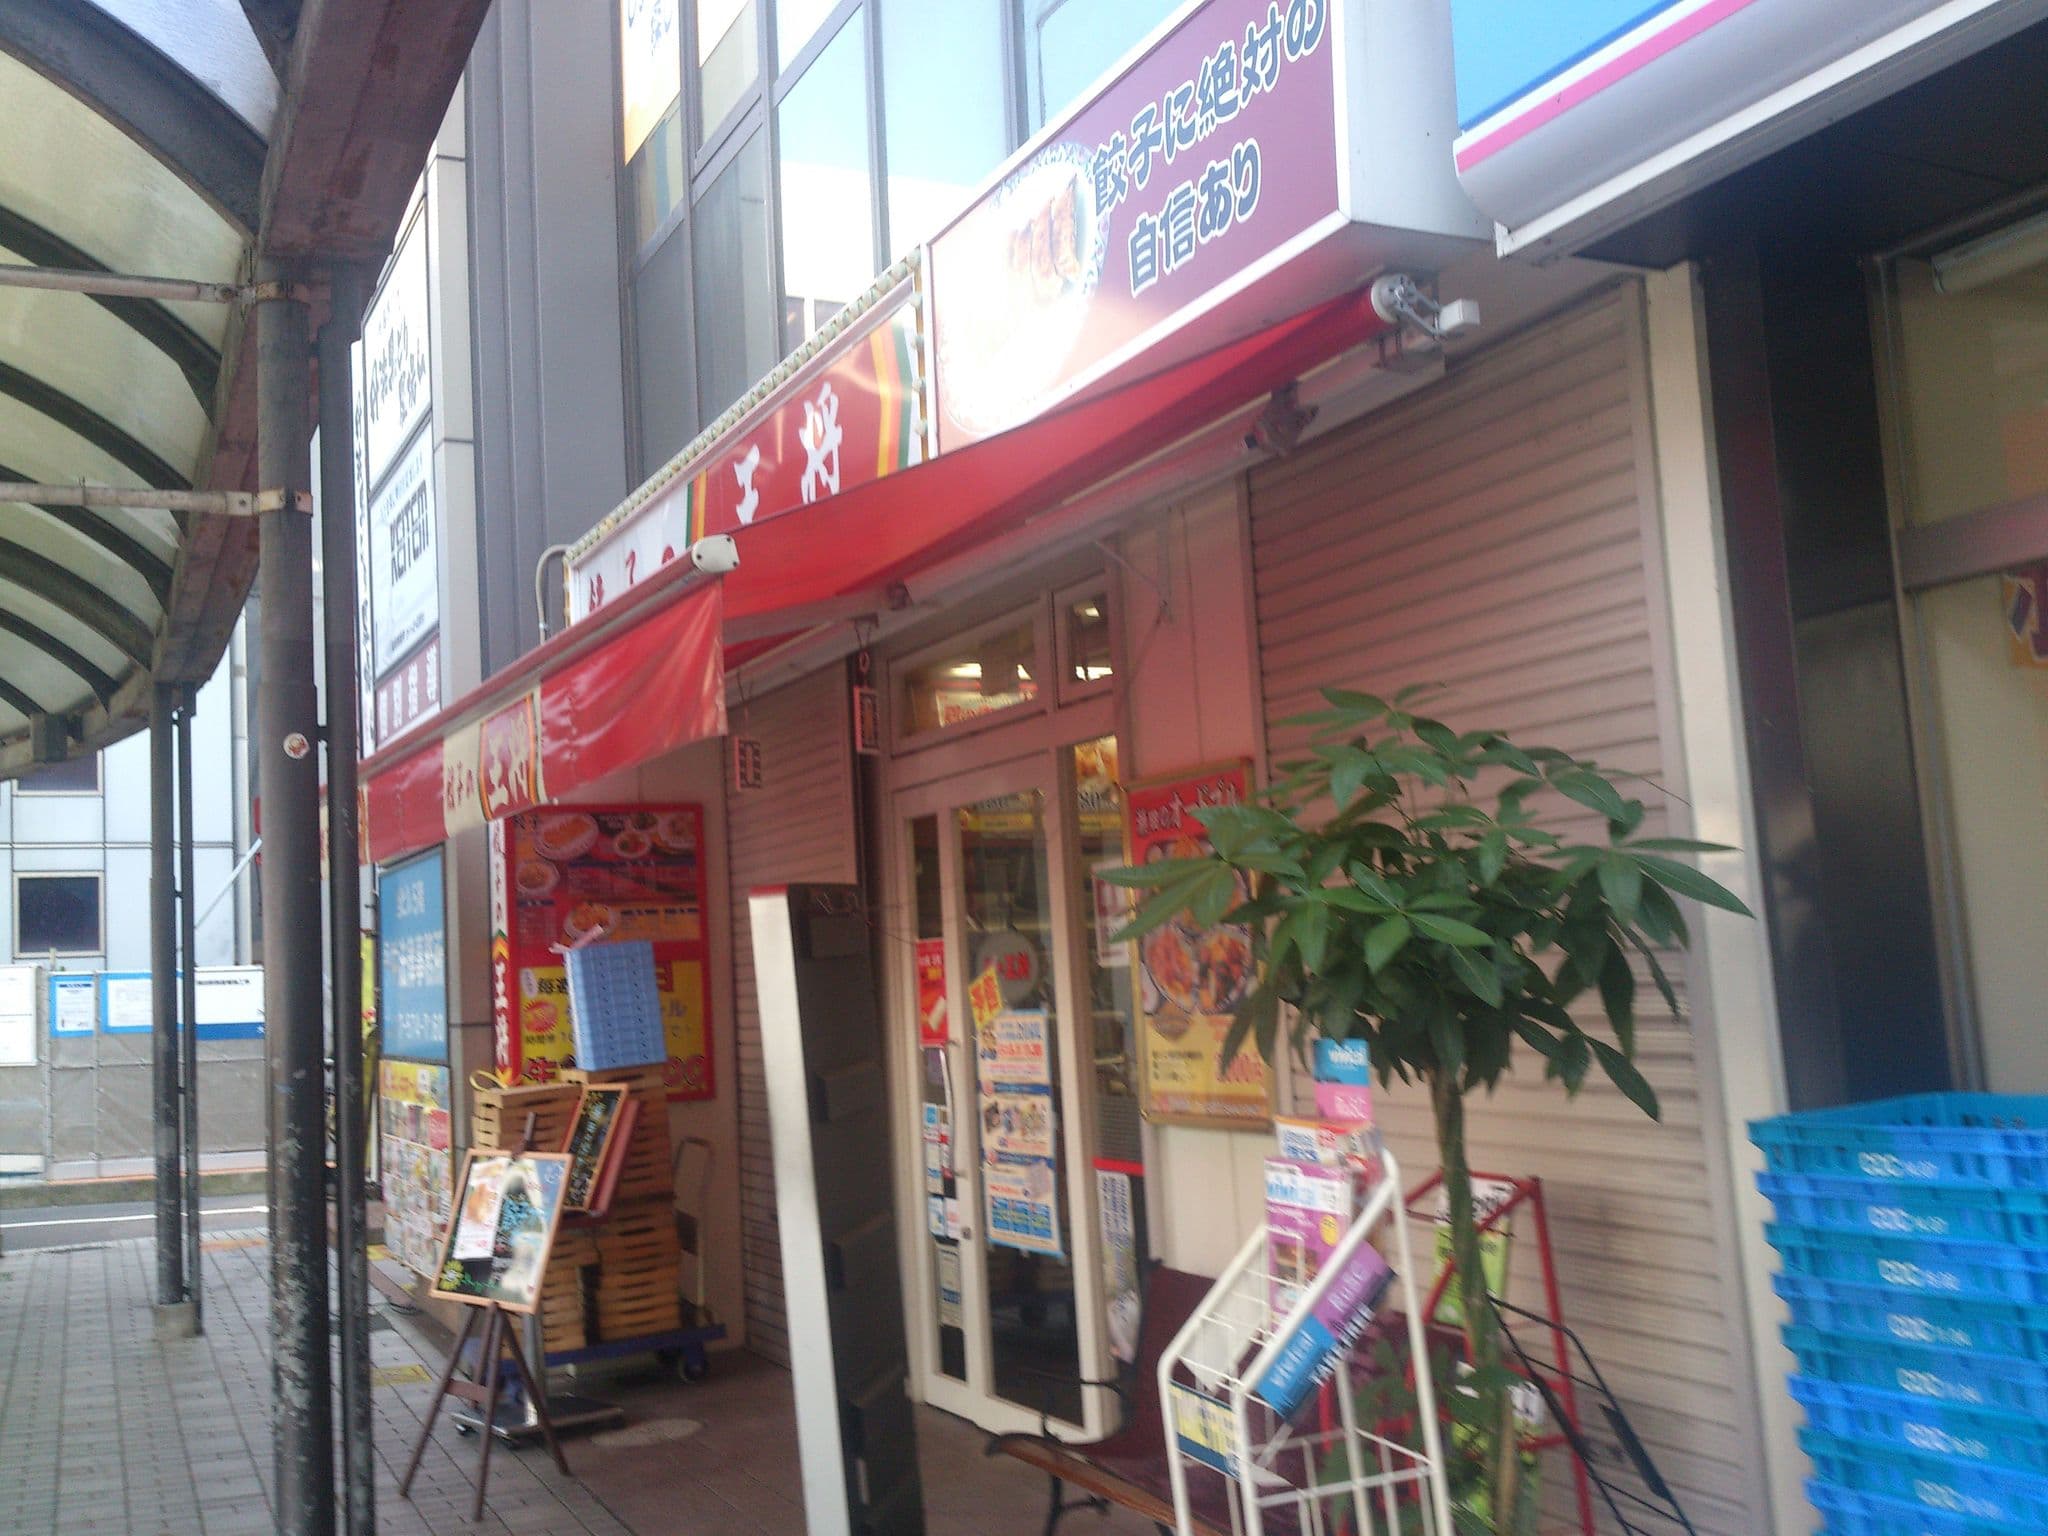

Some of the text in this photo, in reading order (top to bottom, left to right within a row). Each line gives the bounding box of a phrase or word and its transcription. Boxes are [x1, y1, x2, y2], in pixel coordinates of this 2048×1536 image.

[1090, 0, 1328, 218] 餃子に絶対の
[1127, 137, 1264, 298] 自信あり
